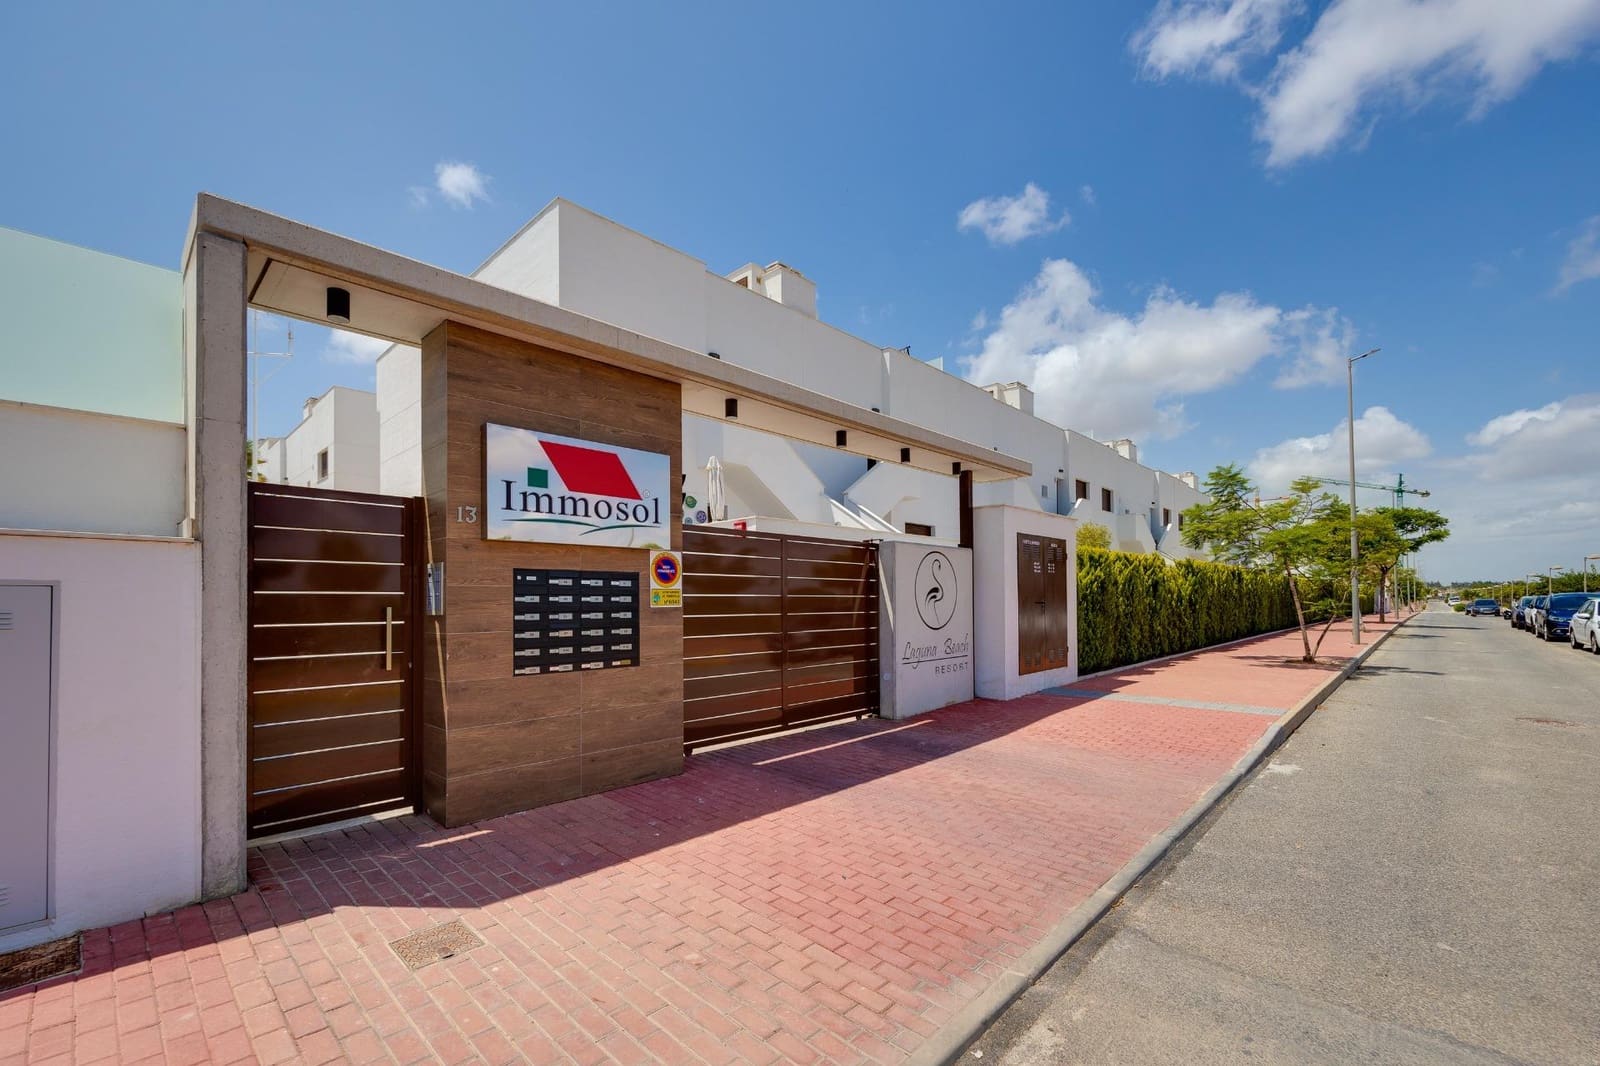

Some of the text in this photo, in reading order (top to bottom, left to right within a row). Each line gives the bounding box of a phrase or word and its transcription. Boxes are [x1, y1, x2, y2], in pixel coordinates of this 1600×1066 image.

[456, 506, 477, 523] 13
[501, 479, 662, 525] Immosol
[902, 632, 968, 670] Laguna Beach
[935, 661, 968, 675] RESORT
